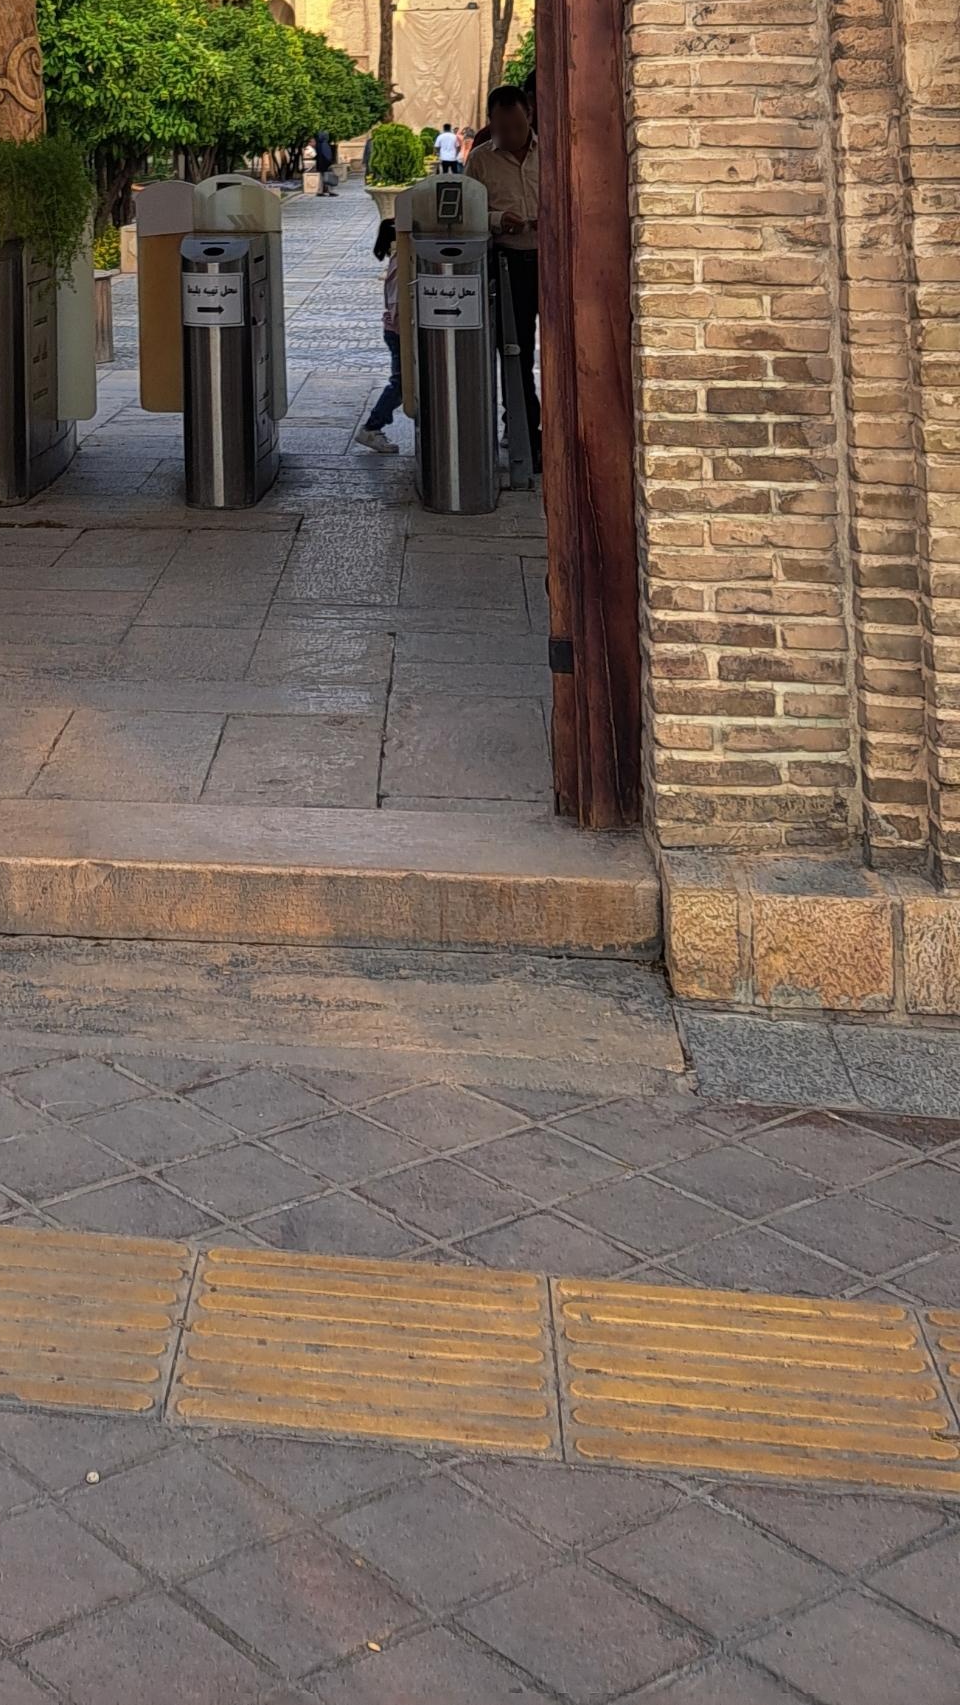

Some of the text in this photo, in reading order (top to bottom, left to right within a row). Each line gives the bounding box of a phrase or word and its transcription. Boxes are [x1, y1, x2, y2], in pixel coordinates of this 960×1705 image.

[186, 284, 238, 297] محل تهیه بلیط
[423, 286, 476, 299] محل تهیه بلیط
